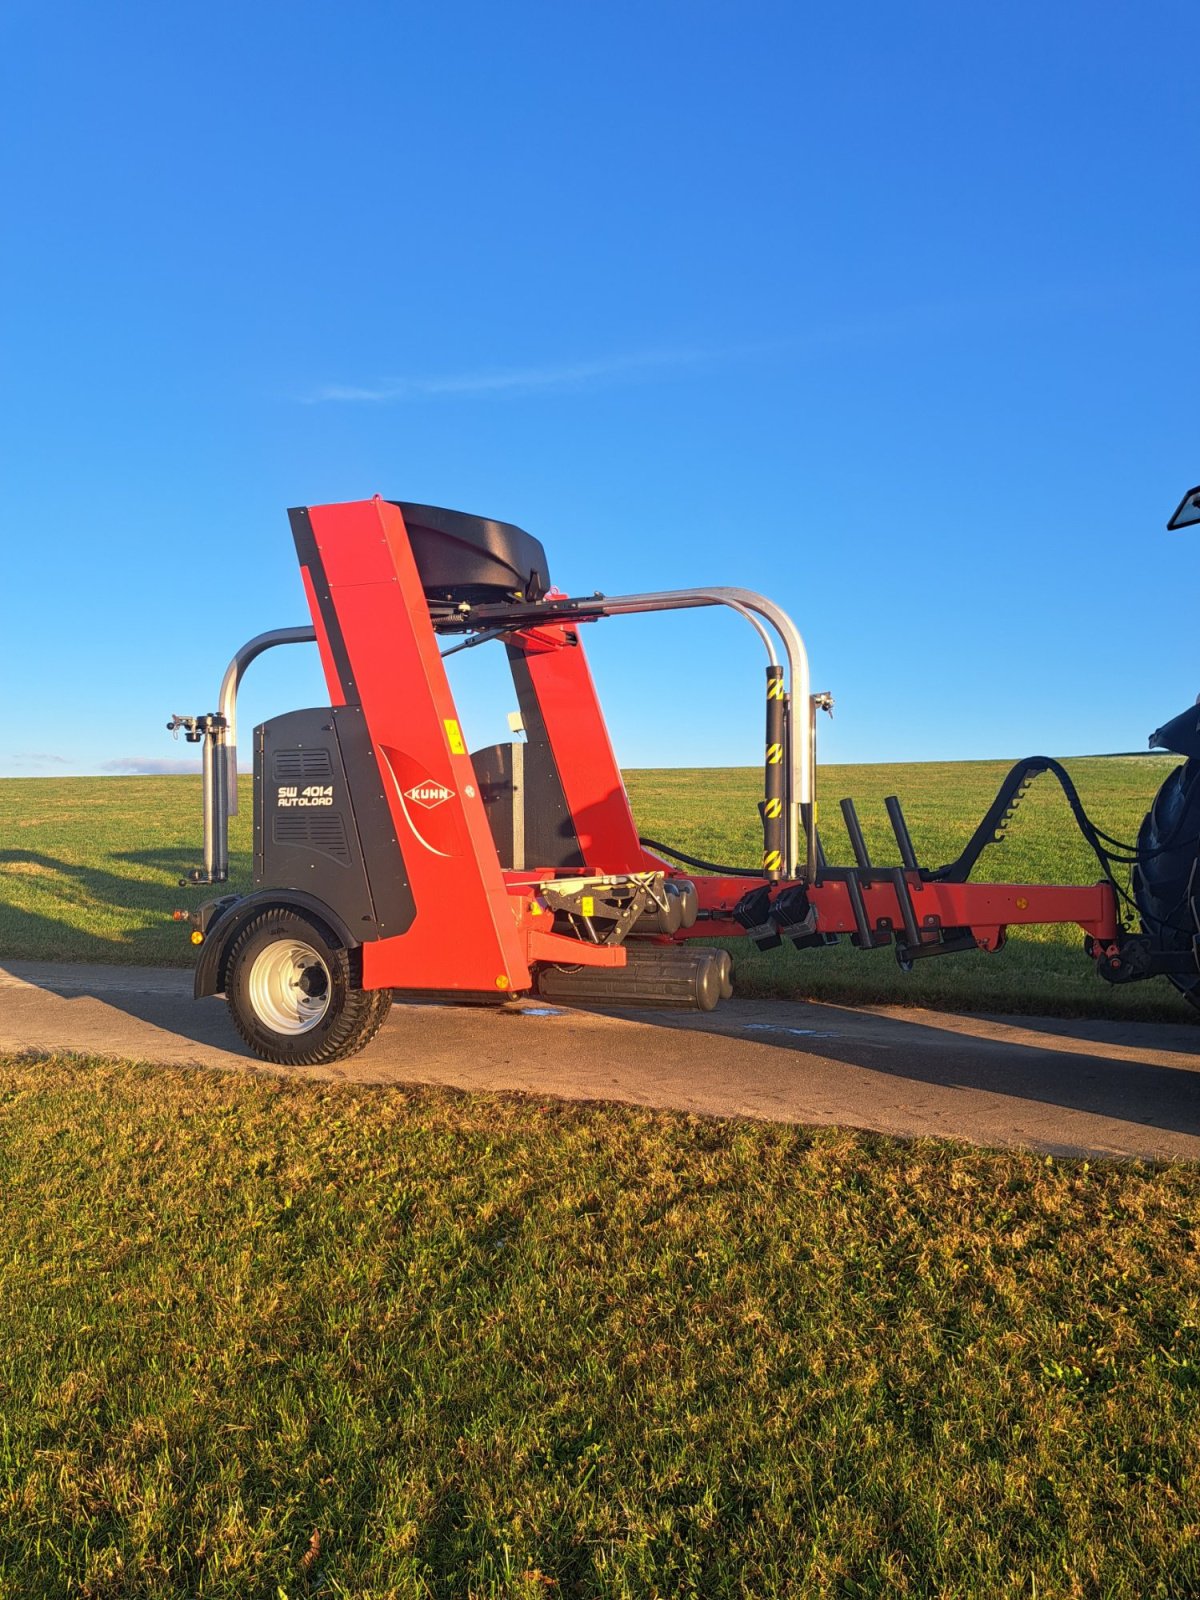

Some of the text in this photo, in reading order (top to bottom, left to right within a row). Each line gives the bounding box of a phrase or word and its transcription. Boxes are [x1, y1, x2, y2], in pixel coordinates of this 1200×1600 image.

[278, 786, 333, 798] SW 4014
[411, 788, 448, 799] KUHN
[278, 797, 333, 807] AUTOLOAD
